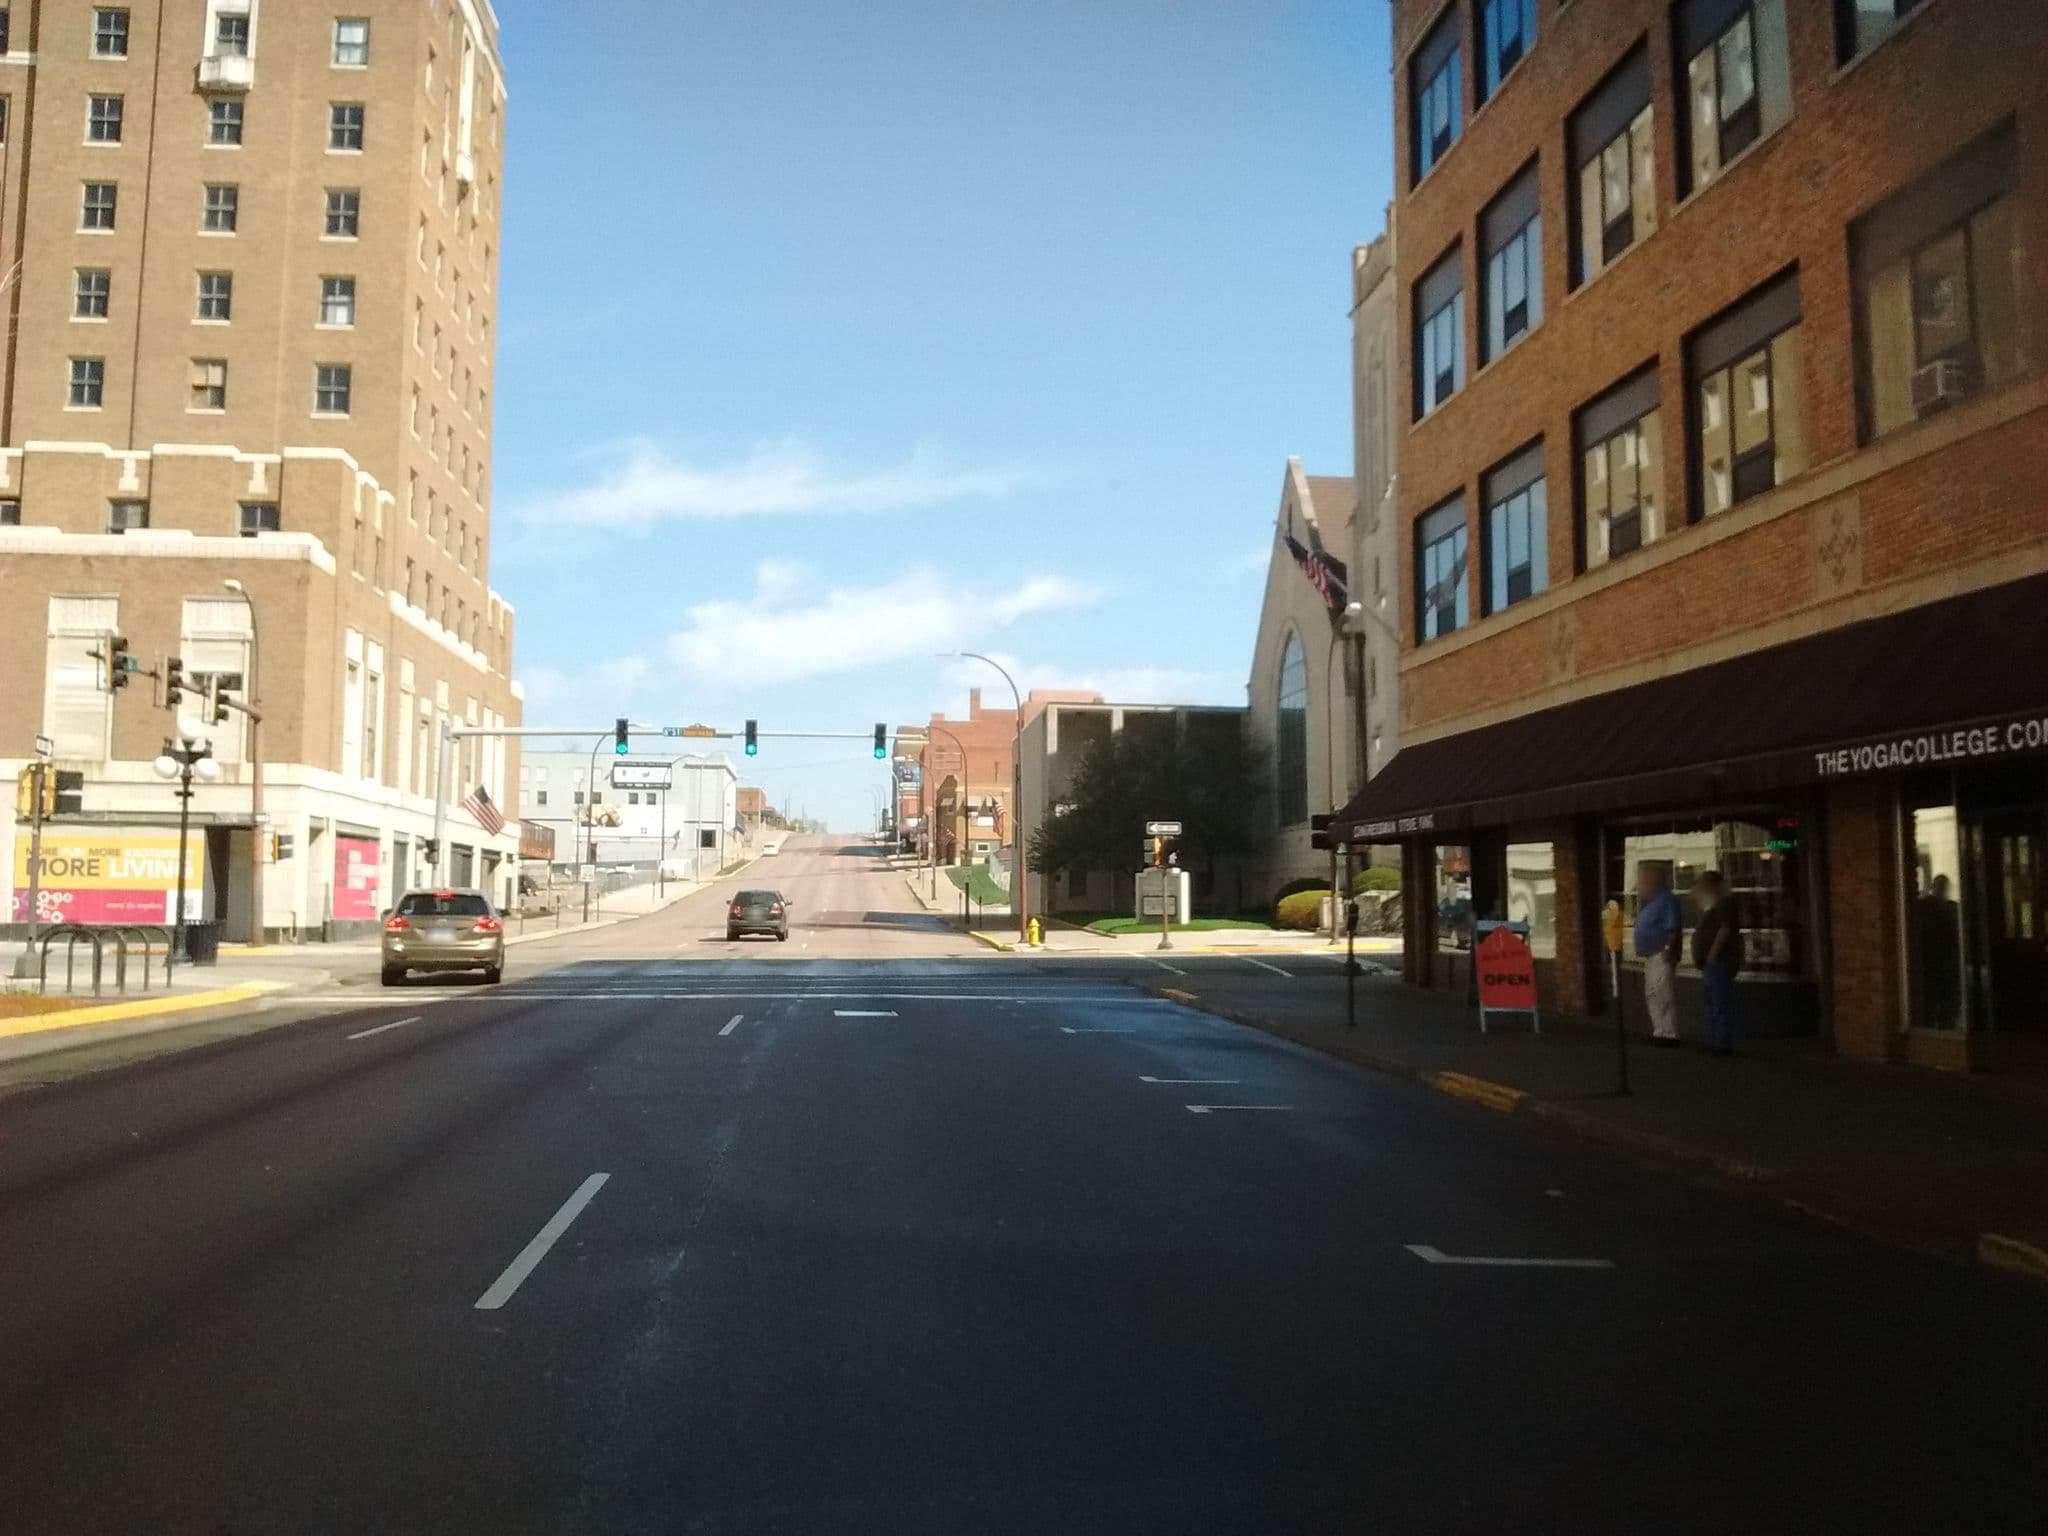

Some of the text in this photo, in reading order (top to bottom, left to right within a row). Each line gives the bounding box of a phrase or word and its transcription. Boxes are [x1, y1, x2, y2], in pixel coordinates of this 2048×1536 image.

[89, 847, 121, 857] MORE
[26, 858, 101, 877] MORE
[1484, 974, 1530, 986] OPEN
